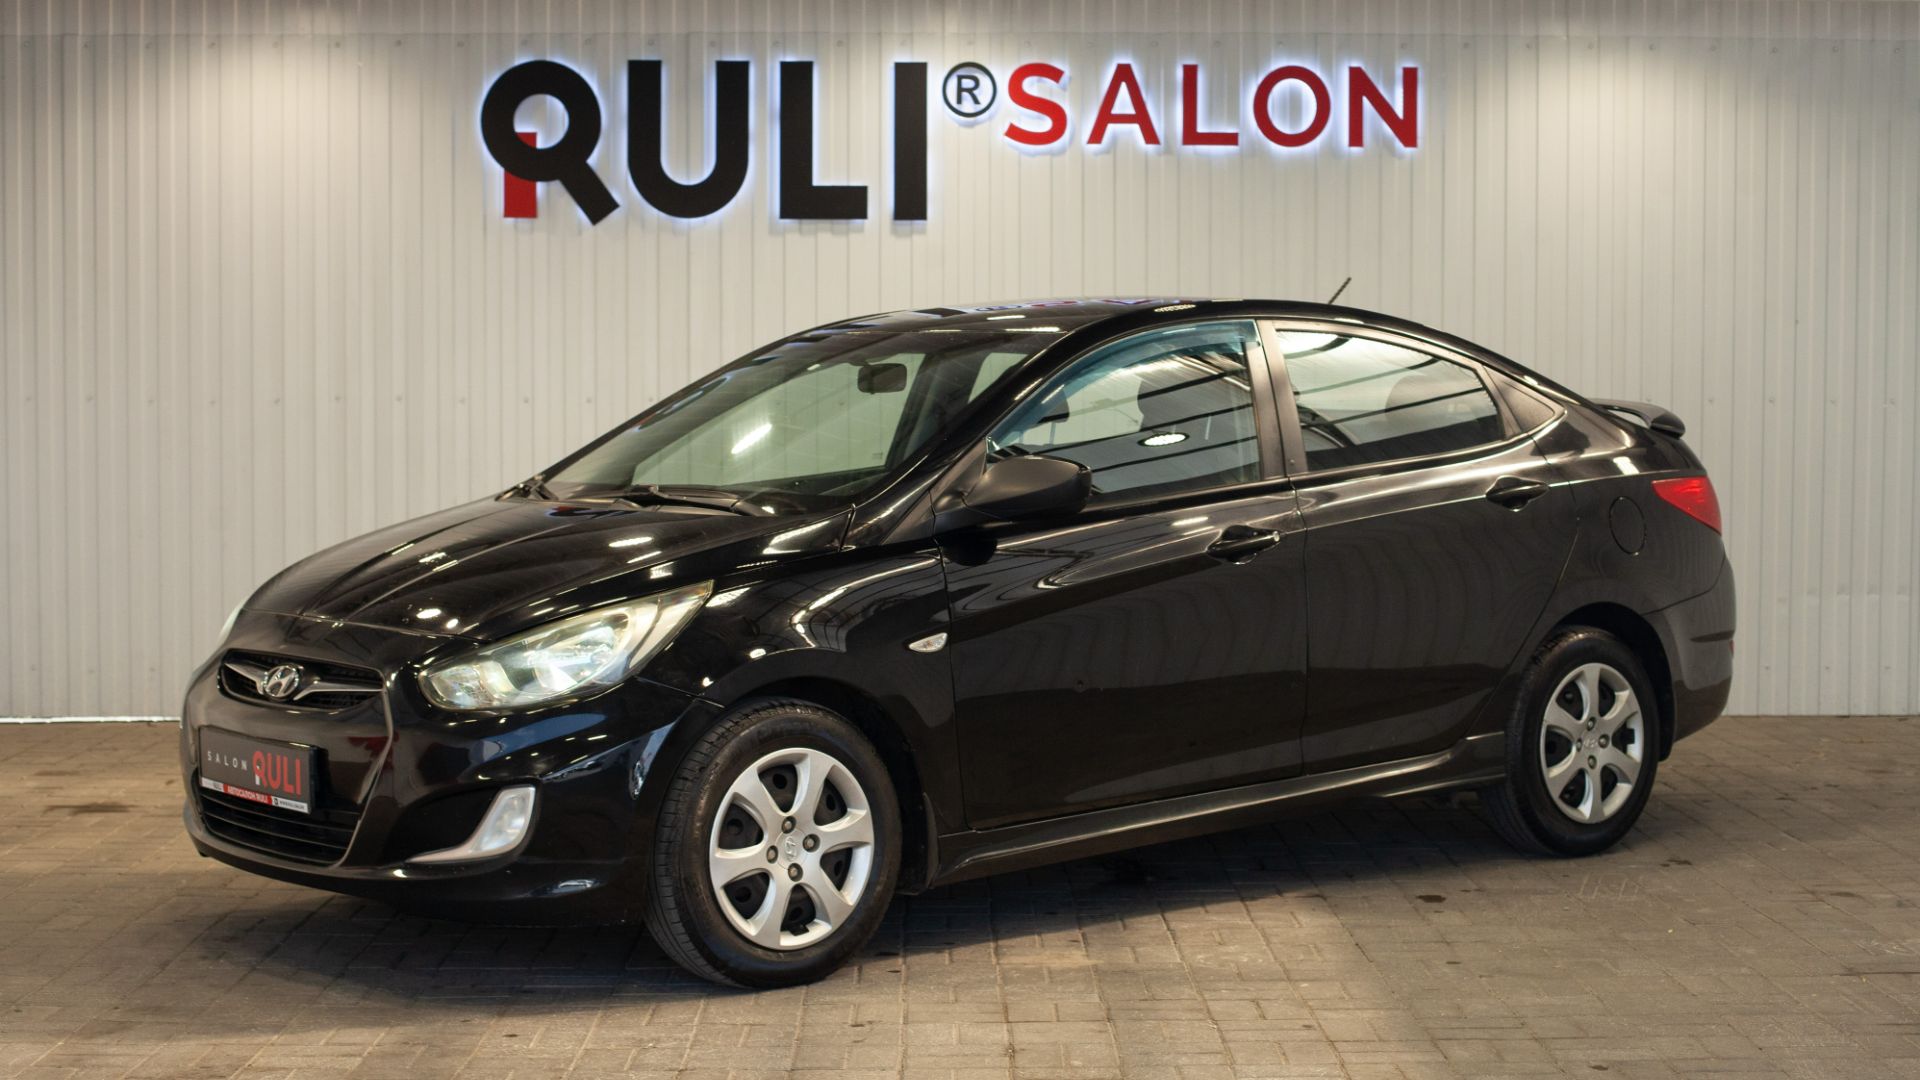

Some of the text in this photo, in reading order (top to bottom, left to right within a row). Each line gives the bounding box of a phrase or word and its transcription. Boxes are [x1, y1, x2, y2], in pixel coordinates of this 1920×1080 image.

[1004, 62, 1419, 149] SALON
[207, 750, 302, 796] SALON RULI
